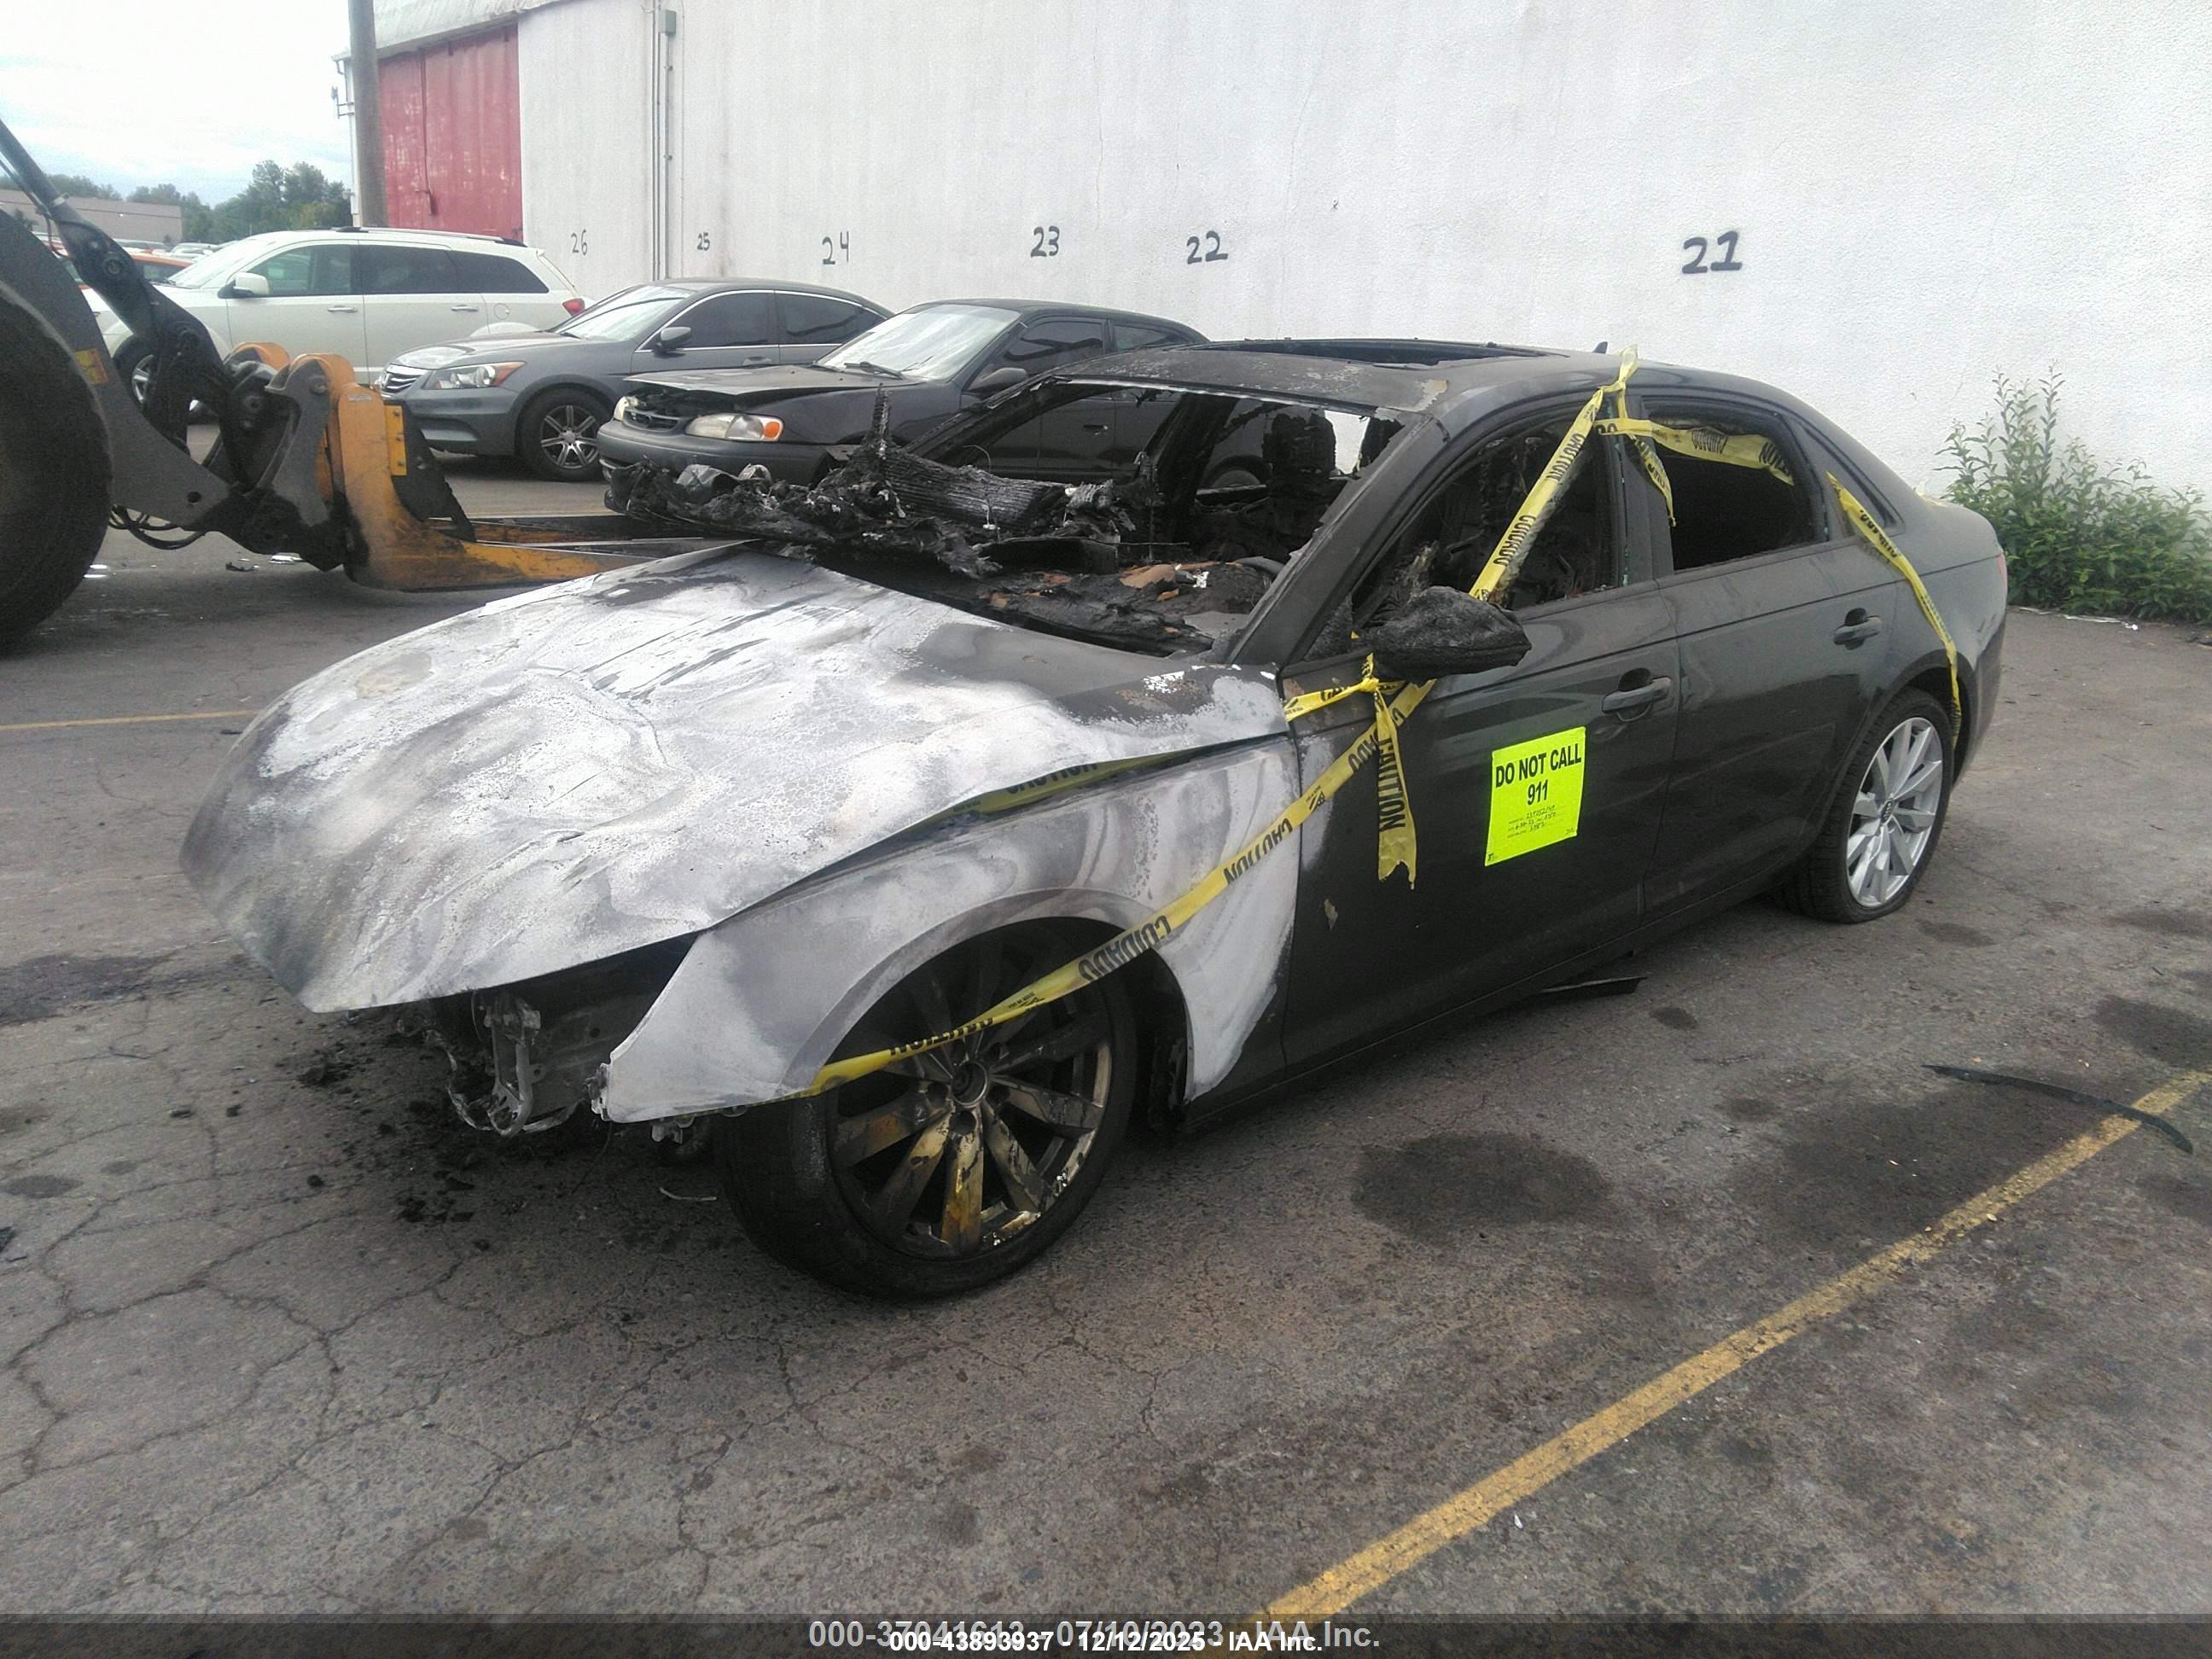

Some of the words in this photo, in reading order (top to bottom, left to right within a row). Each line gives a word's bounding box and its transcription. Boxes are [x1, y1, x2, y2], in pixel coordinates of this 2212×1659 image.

[571, 229, 589, 256] 26
[696, 231, 711, 252] 25
[822, 230, 850, 265] 24
[1030, 225, 1061, 258] 23
[1186, 230, 1229, 265] 22
[1681, 230, 1743, 274] 21
[1545, 433, 1586, 481] CAUTION
[1493, 514, 1537, 567] CUIDADO
[1377, 737, 1407, 833] CAUTION
[1495, 762, 1516, 788] DO
[1519, 753, 1547, 780] NOT
[1550, 742, 1582, 771] CALL
[1527, 779, 1549, 806] 911
[1223, 817, 1294, 886] CAUTION
[1078, 914, 1173, 982] CUIDADO
